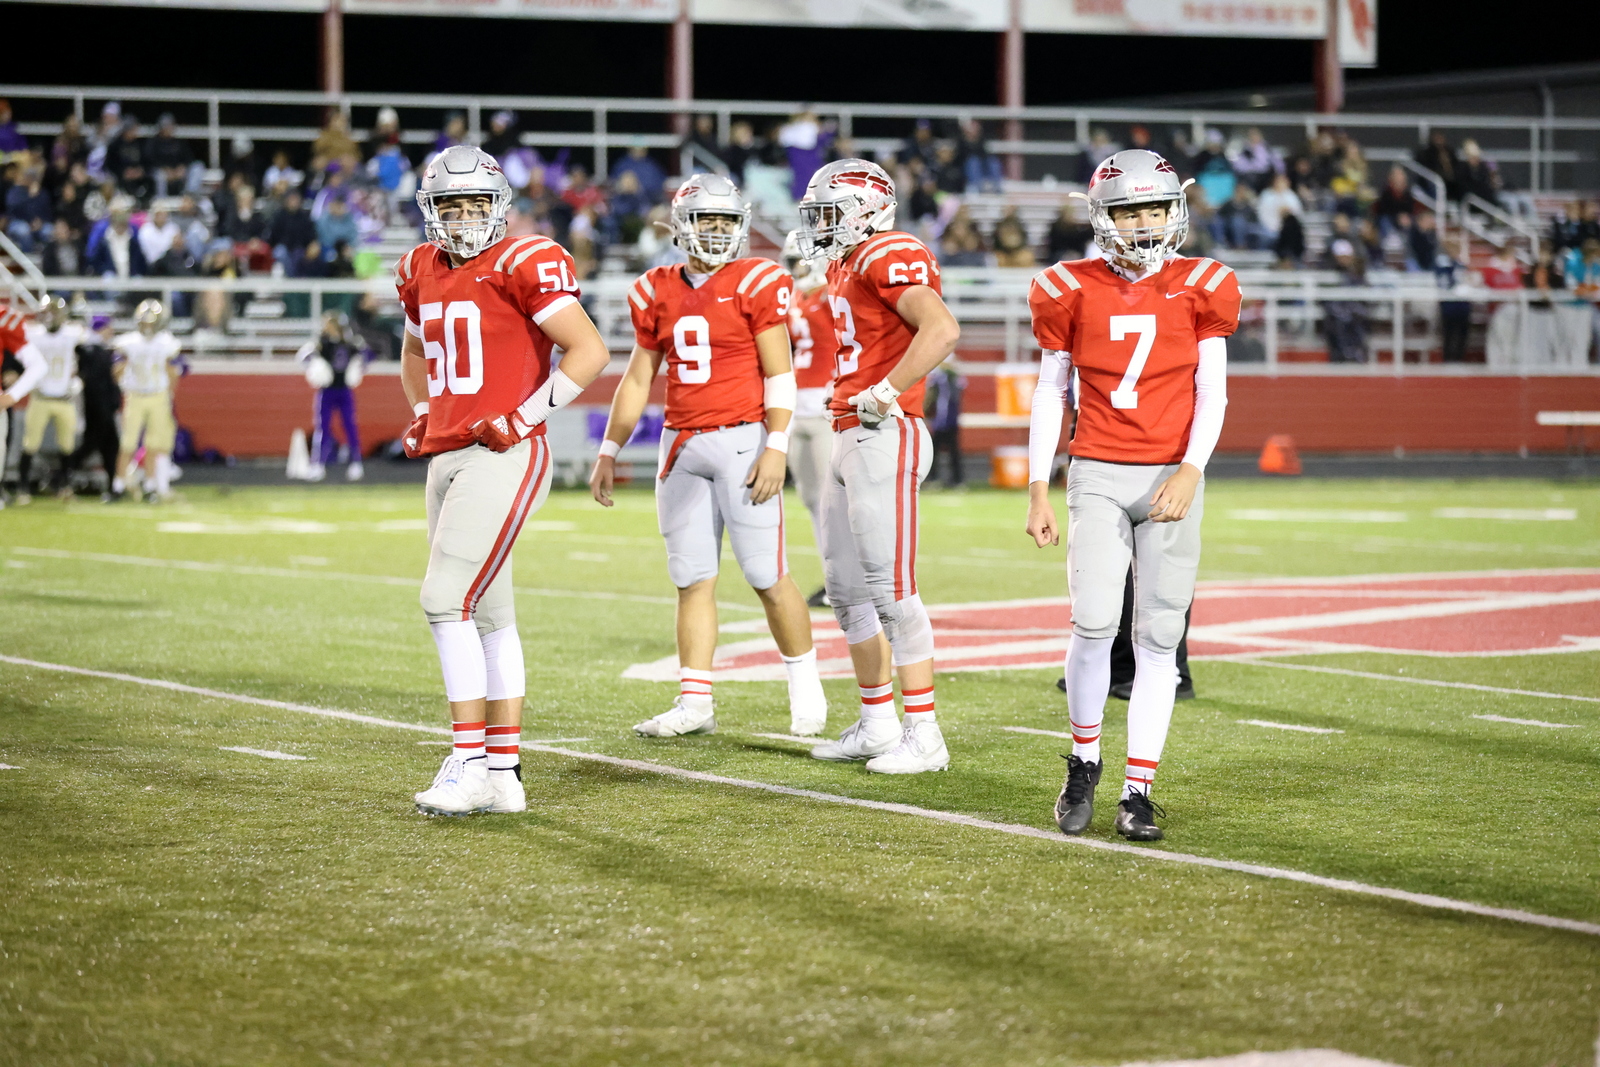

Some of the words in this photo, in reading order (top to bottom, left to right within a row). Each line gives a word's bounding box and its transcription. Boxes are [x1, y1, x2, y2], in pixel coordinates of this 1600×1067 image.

[536, 260, 579, 293] 50
[776, 286, 791, 315] 9
[888, 261, 929, 285] 63
[419, 300, 484, 397] 50
[673, 315, 713, 384] 9
[827, 294, 863, 376] 3
[1109, 314, 1157, 409] 7
